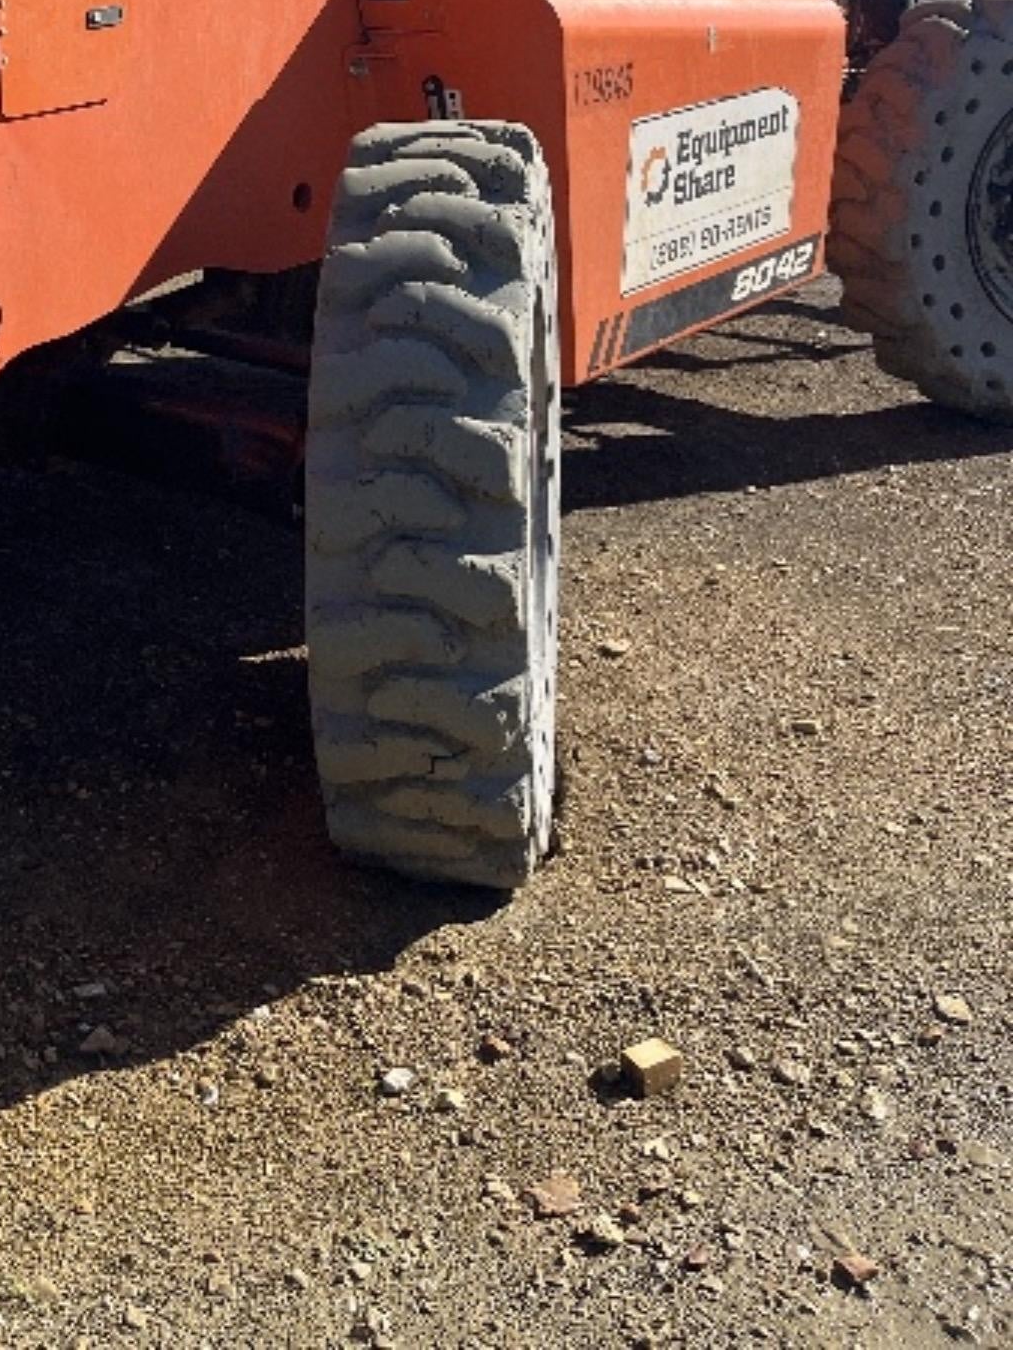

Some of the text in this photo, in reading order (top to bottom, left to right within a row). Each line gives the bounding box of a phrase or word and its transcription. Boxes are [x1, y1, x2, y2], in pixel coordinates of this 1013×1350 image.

[676, 104, 790, 166] Equipment
[672, 163, 736, 206] Share
[730, 242, 814, 301] 8042
